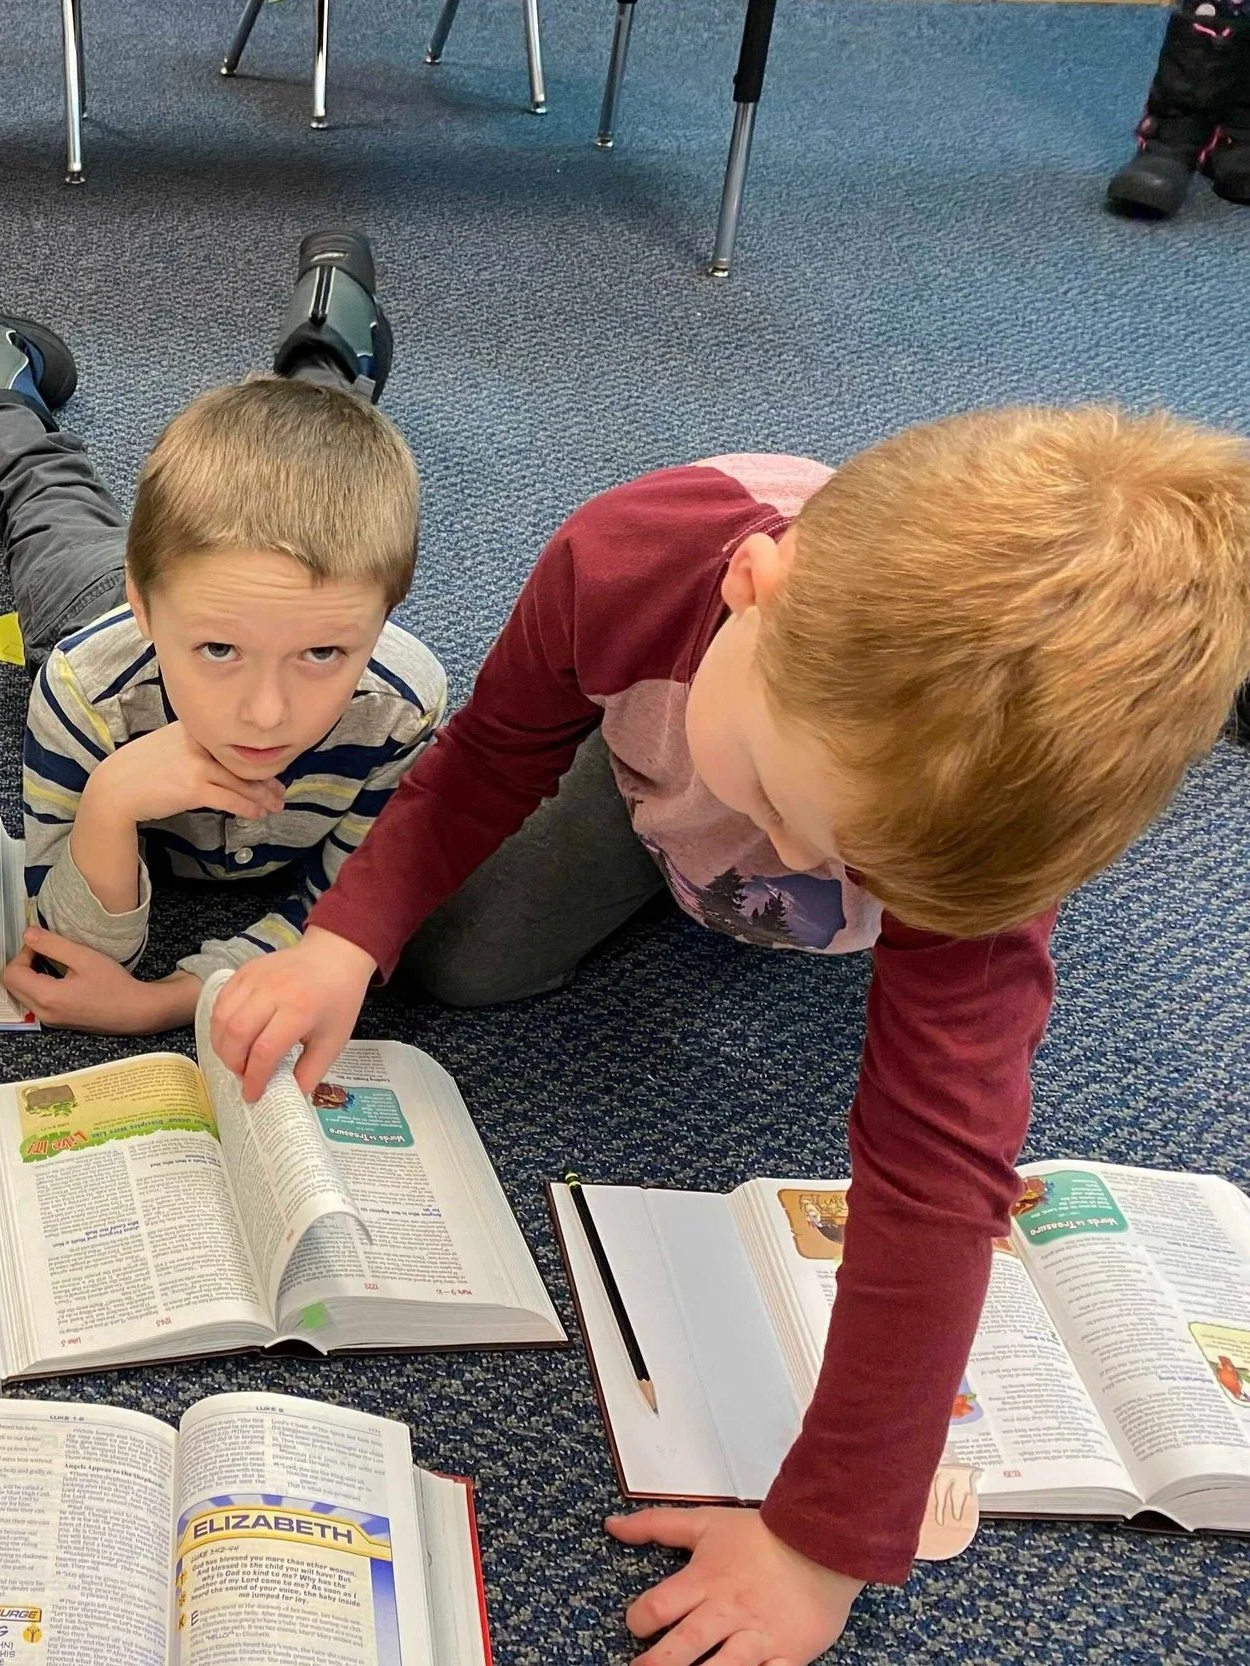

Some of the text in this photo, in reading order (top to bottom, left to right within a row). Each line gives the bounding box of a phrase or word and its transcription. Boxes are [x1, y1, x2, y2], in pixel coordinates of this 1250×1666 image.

[112, 1126, 128, 1136] Were
[129, 1120, 163, 1130] Disciples
[329, 1128, 369, 1141] Treasure
[379, 1135, 405, 1143] Words
[1030, 1220, 1077, 1235] Treasure
[1087, 1217, 1118, 1227] Words
[193, 1514, 353, 1544] ELIZABETH
[211, 1563, 239, 1572] blessed
[265, 1562, 283, 1570] child
[316, 1570, 335, 1578] have!
[338, 1575, 352, 1584] But
[306, 1561, 328, 1570] other
[329, 1566, 357, 1577] women.
[202, 1574, 215, 1582] why
[300, 1575, 316, 1584] Why
[194, 1581, 217, 1593] mother
[324, 1587, 341, 1596] soon
[191, 1590, 209, 1601] heard
[279, 1588, 302, 1596] voice,
[319, 1593, 337, 1602] baby
[338, 1597, 361, 1607] inside
[252, 1592, 280, 1600] jumped
[295, 1596, 309, 1605] joy.
[0, 1650, 16, 1658] HIS
